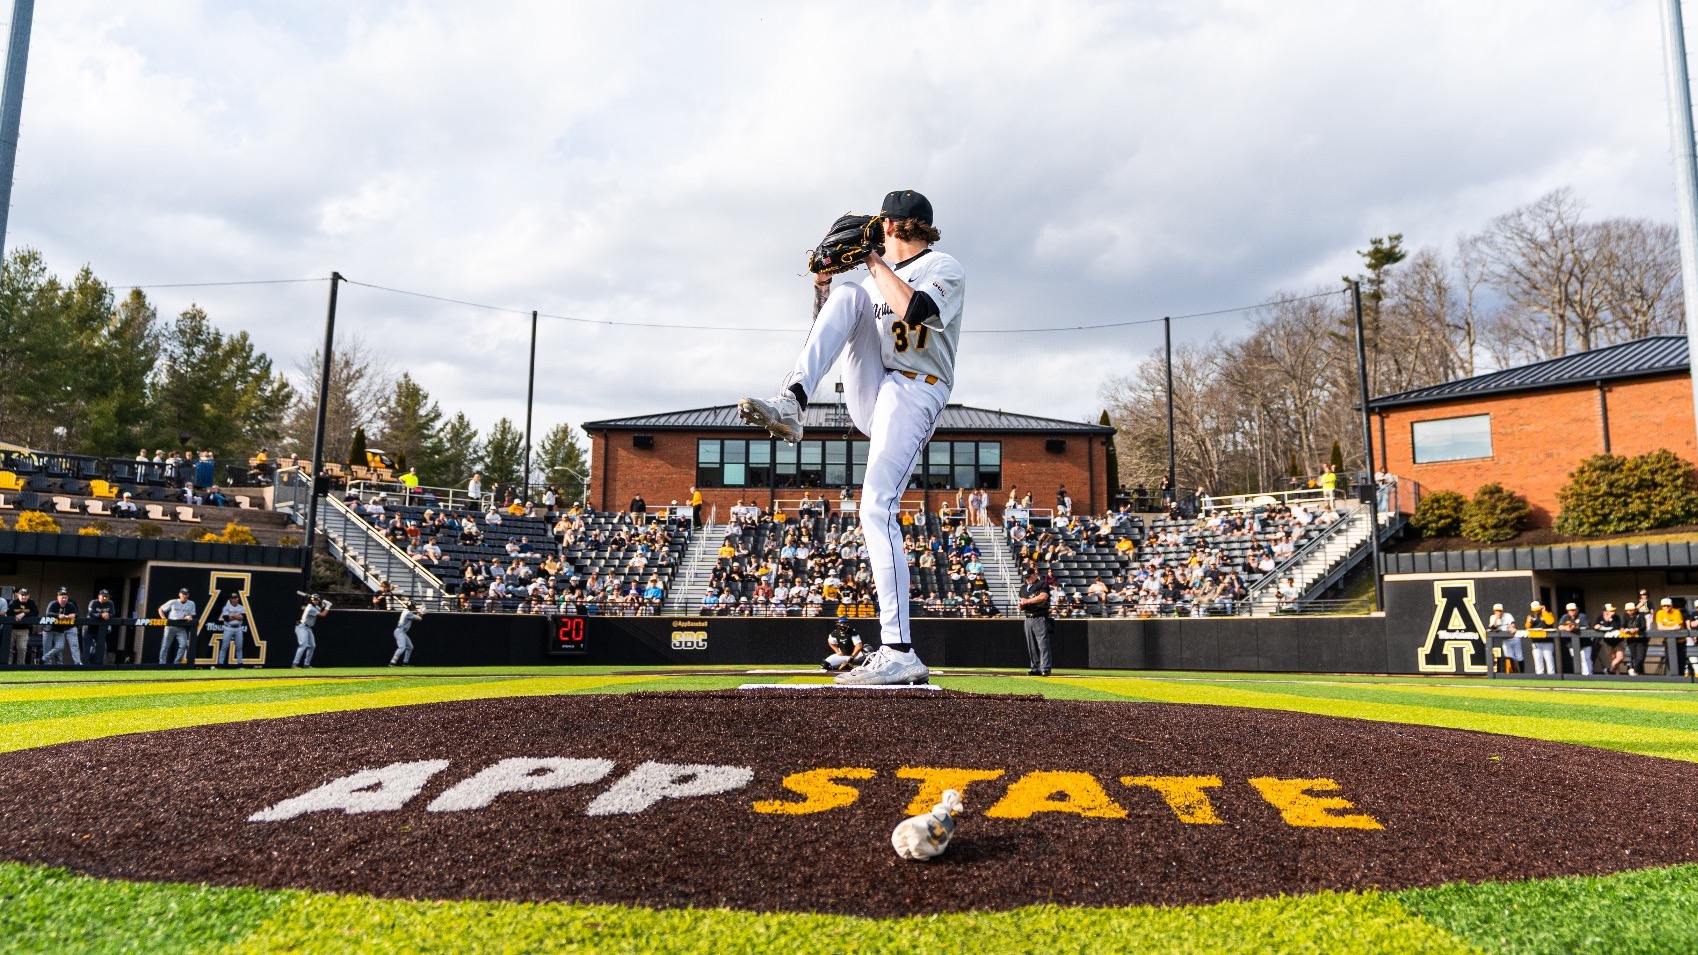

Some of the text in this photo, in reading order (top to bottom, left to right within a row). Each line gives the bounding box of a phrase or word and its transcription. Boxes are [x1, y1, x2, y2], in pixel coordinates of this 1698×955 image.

[891, 319, 930, 354] 37
[182, 571, 267, 665] A
[559, 618, 584, 641] 20
[1418, 579, 1502, 672] A
[671, 631, 708, 650] SBC
